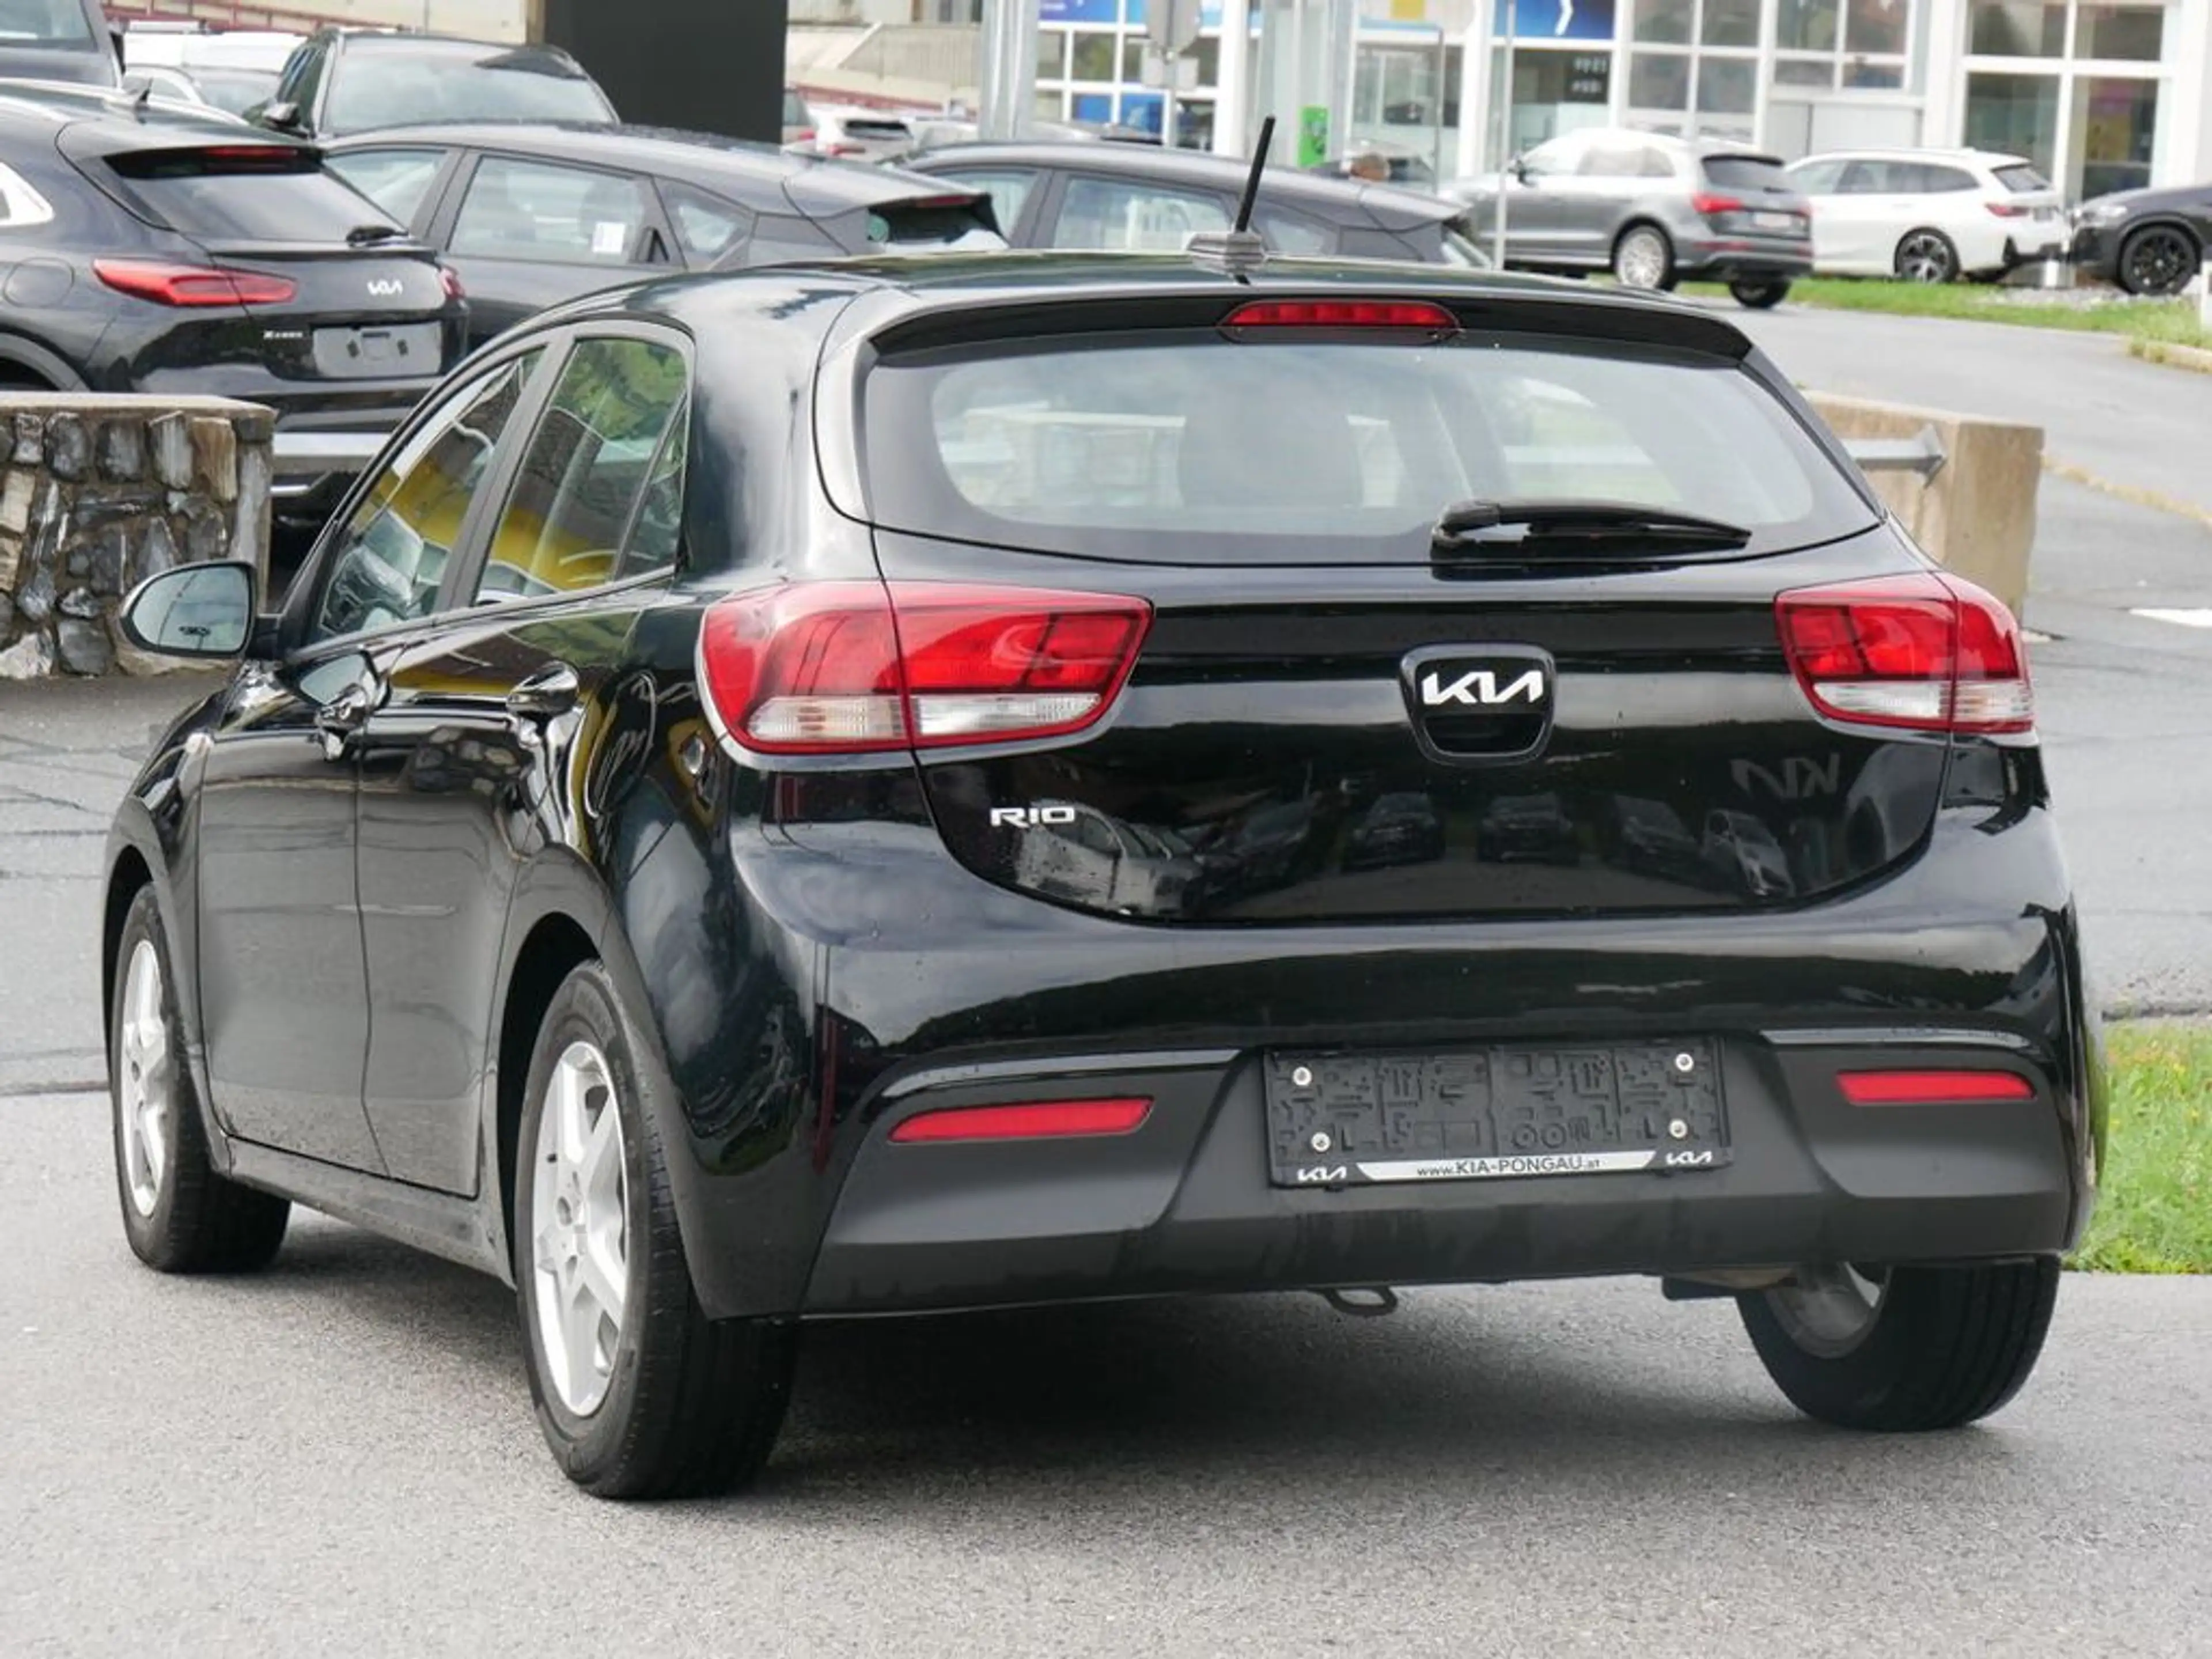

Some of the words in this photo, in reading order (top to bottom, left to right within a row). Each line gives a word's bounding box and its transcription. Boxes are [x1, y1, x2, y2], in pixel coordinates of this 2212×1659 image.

[1422, 669, 1543, 705] KIA
[990, 807, 1075, 828] RIO
[1666, 1151, 1713, 1164] KIA
[1297, 1165, 1347, 1181] KIA
